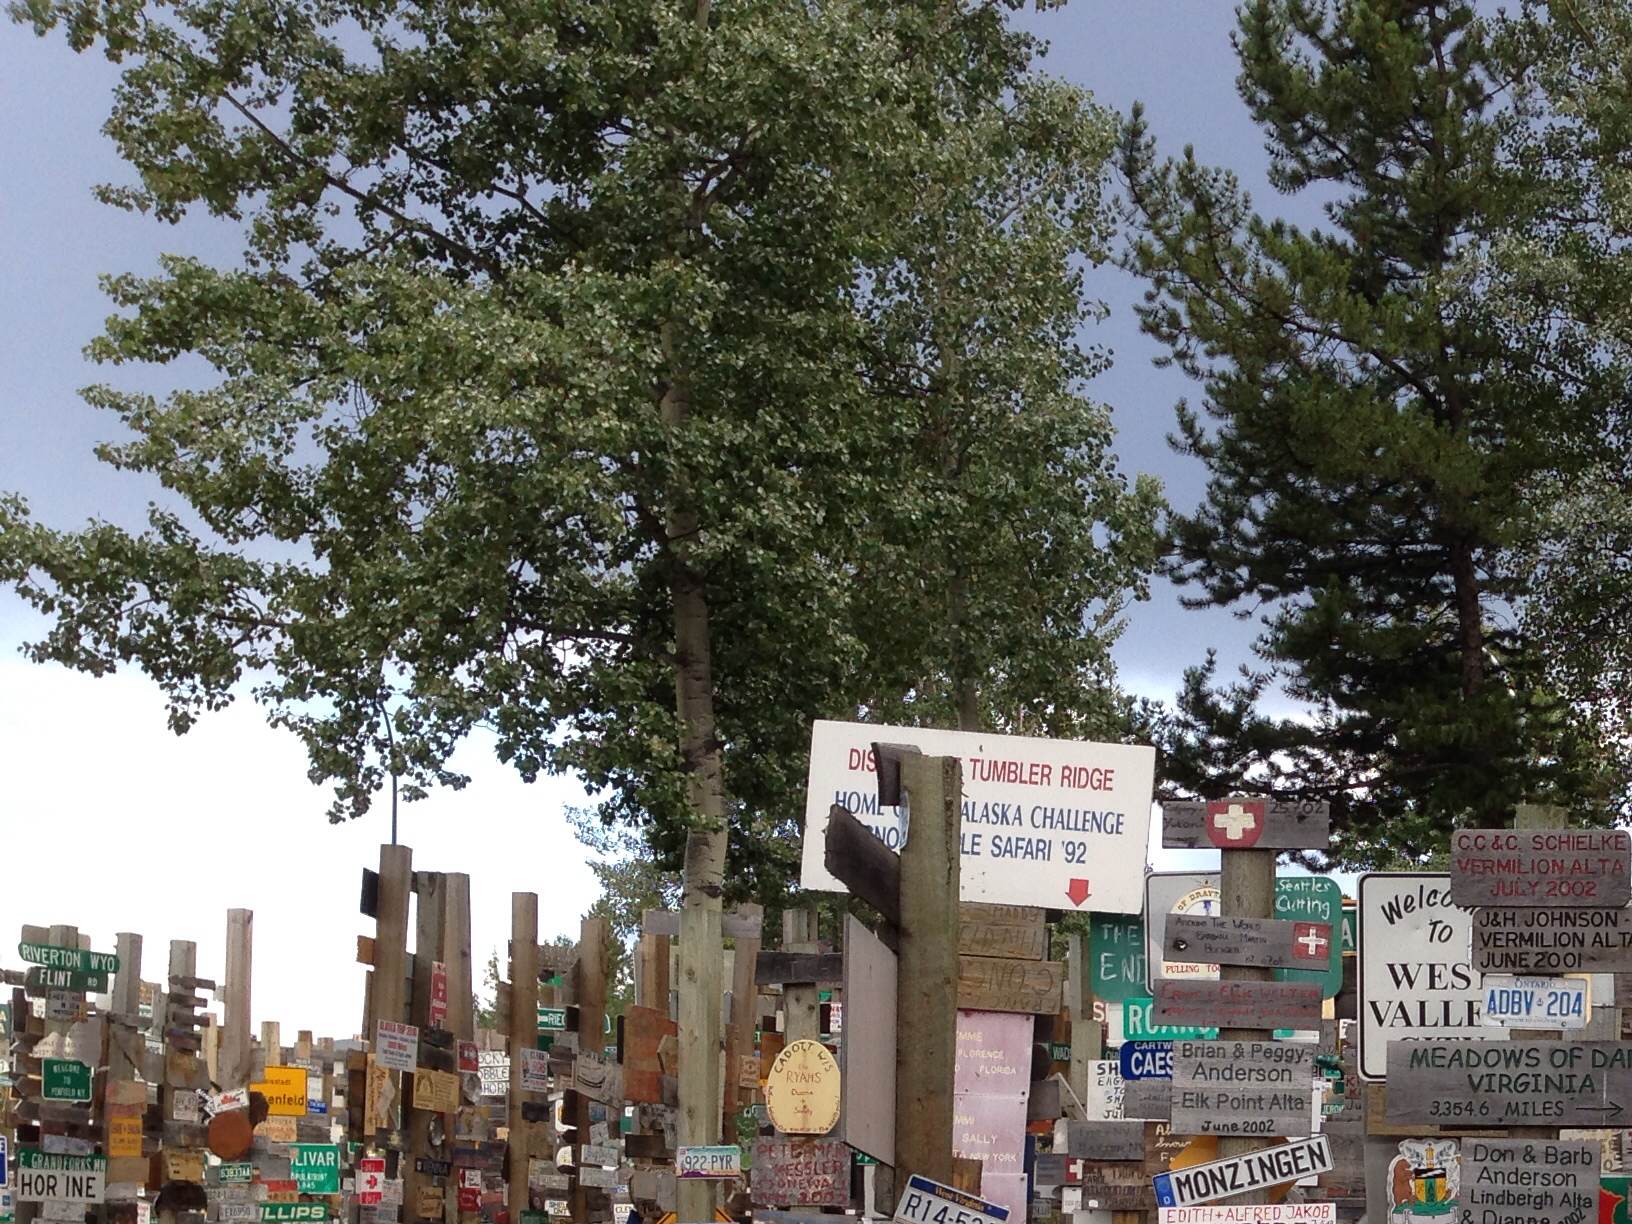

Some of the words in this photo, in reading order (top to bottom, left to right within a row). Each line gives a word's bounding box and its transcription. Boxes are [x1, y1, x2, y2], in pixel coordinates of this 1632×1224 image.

[970, 758, 1053, 787] TUMBLER
[1060, 765, 1115, 793] RIDGE
[1030, 807, 1125, 836] CHALLENGE
[991, 837, 1052, 863] SAFARI
[1062, 839, 1088, 865] '92
[1532, 835, 1627, 851] SCHIELKE
[1457, 858, 1565, 875] VERMILION
[1571, 858, 1625, 874] ALTA
[1490, 881, 1539, 898] JULY
[1546, 881, 1597, 897] 2002
[1524, 911, 1619, 929] JOHNSON
[1480, 931, 1586, 949] VERMILION
[22, 945, 81, 967] RIVERTON
[90, 953, 115, 972] WYO
[1479, 952, 1530, 969] JUNE
[1534, 952, 1583, 969] 2001
[39, 969, 72, 987] FLINT
[1487, 991, 1533, 1016] ADBV
[1547, 991, 1583, 1017] 204
[1408, 1047, 1540, 1069] MEADOWS
[1549, 1047, 1584, 1068] OF
[1192, 1063, 1293, 1083] Anderson
[1467, 1073, 1597, 1094] VIRGINIA
[1221, 1092, 1264, 1111] Point
[1504, 1101, 1566, 1118] MILES
[1201, 1121, 1240, 1134] June
[1243, 1119, 1276, 1134] 2002
[1472, 1144, 1515, 1164] Don
[1544, 1144, 1594, 1166] Barb
[1176, 1141, 1328, 1202] MONZINGEN
[1476, 1167, 1578, 1188] Anderson
[21, 1175, 56, 1197] HOR
[64, 1175, 96, 1198] INE
[1470, 1189, 1555, 1210] Lindbergh
[1560, 1191, 1593, 1210] Alta
[1286, 1204, 1330, 1221] JAKOB
